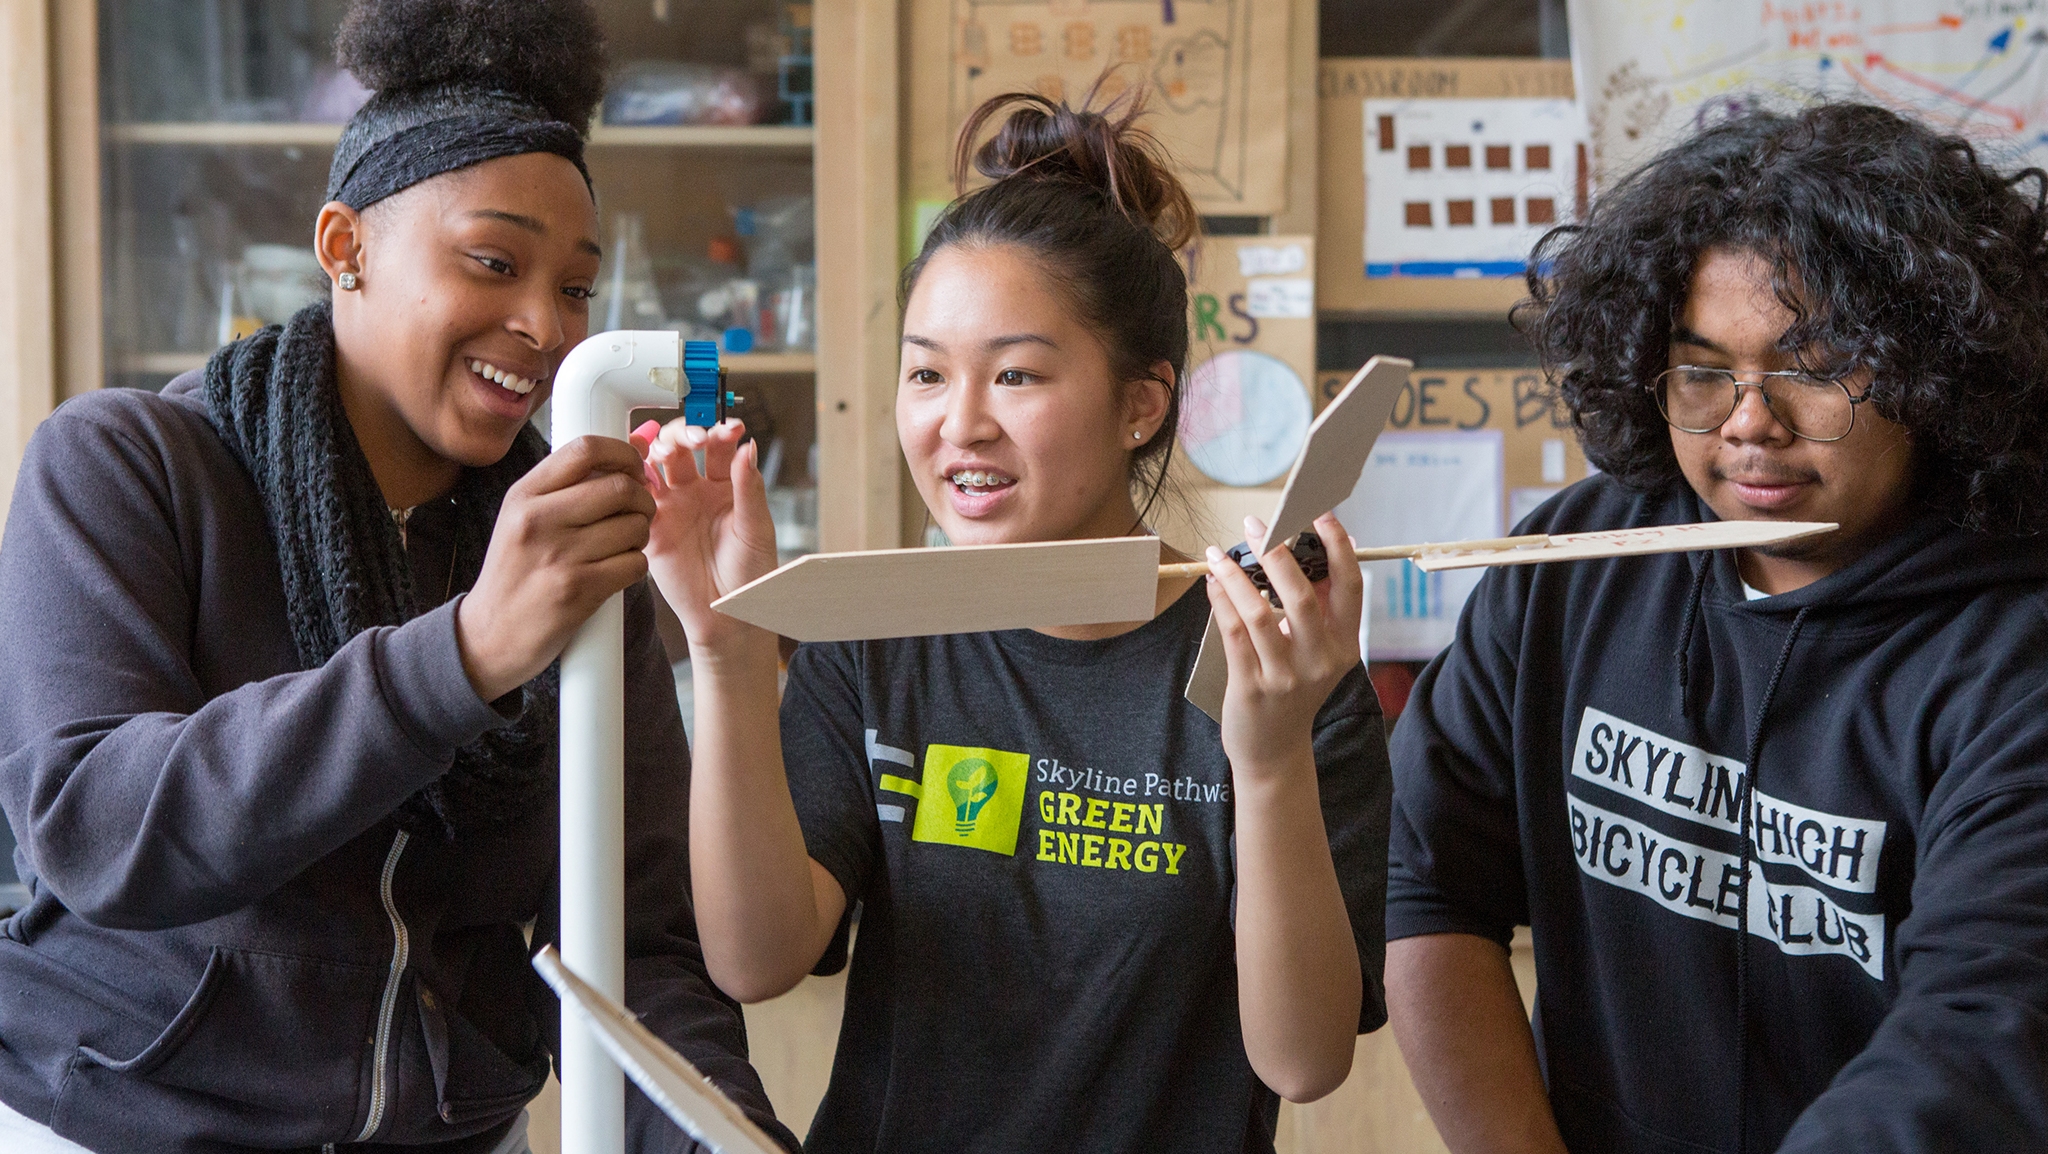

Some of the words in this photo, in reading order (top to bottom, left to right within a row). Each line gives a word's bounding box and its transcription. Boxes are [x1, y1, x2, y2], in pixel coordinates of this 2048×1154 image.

[1035, 757, 1137, 797] Skyline
[1143, 772, 1230, 803] Pathwa
[1585, 722, 1749, 824] SKYLIN
[1038, 790, 1164, 836] GREEN
[1755, 800, 1869, 884] HIGH
[1036, 828, 1187, 876] ENERGY
[1571, 803, 1752, 917] BICYCLE
